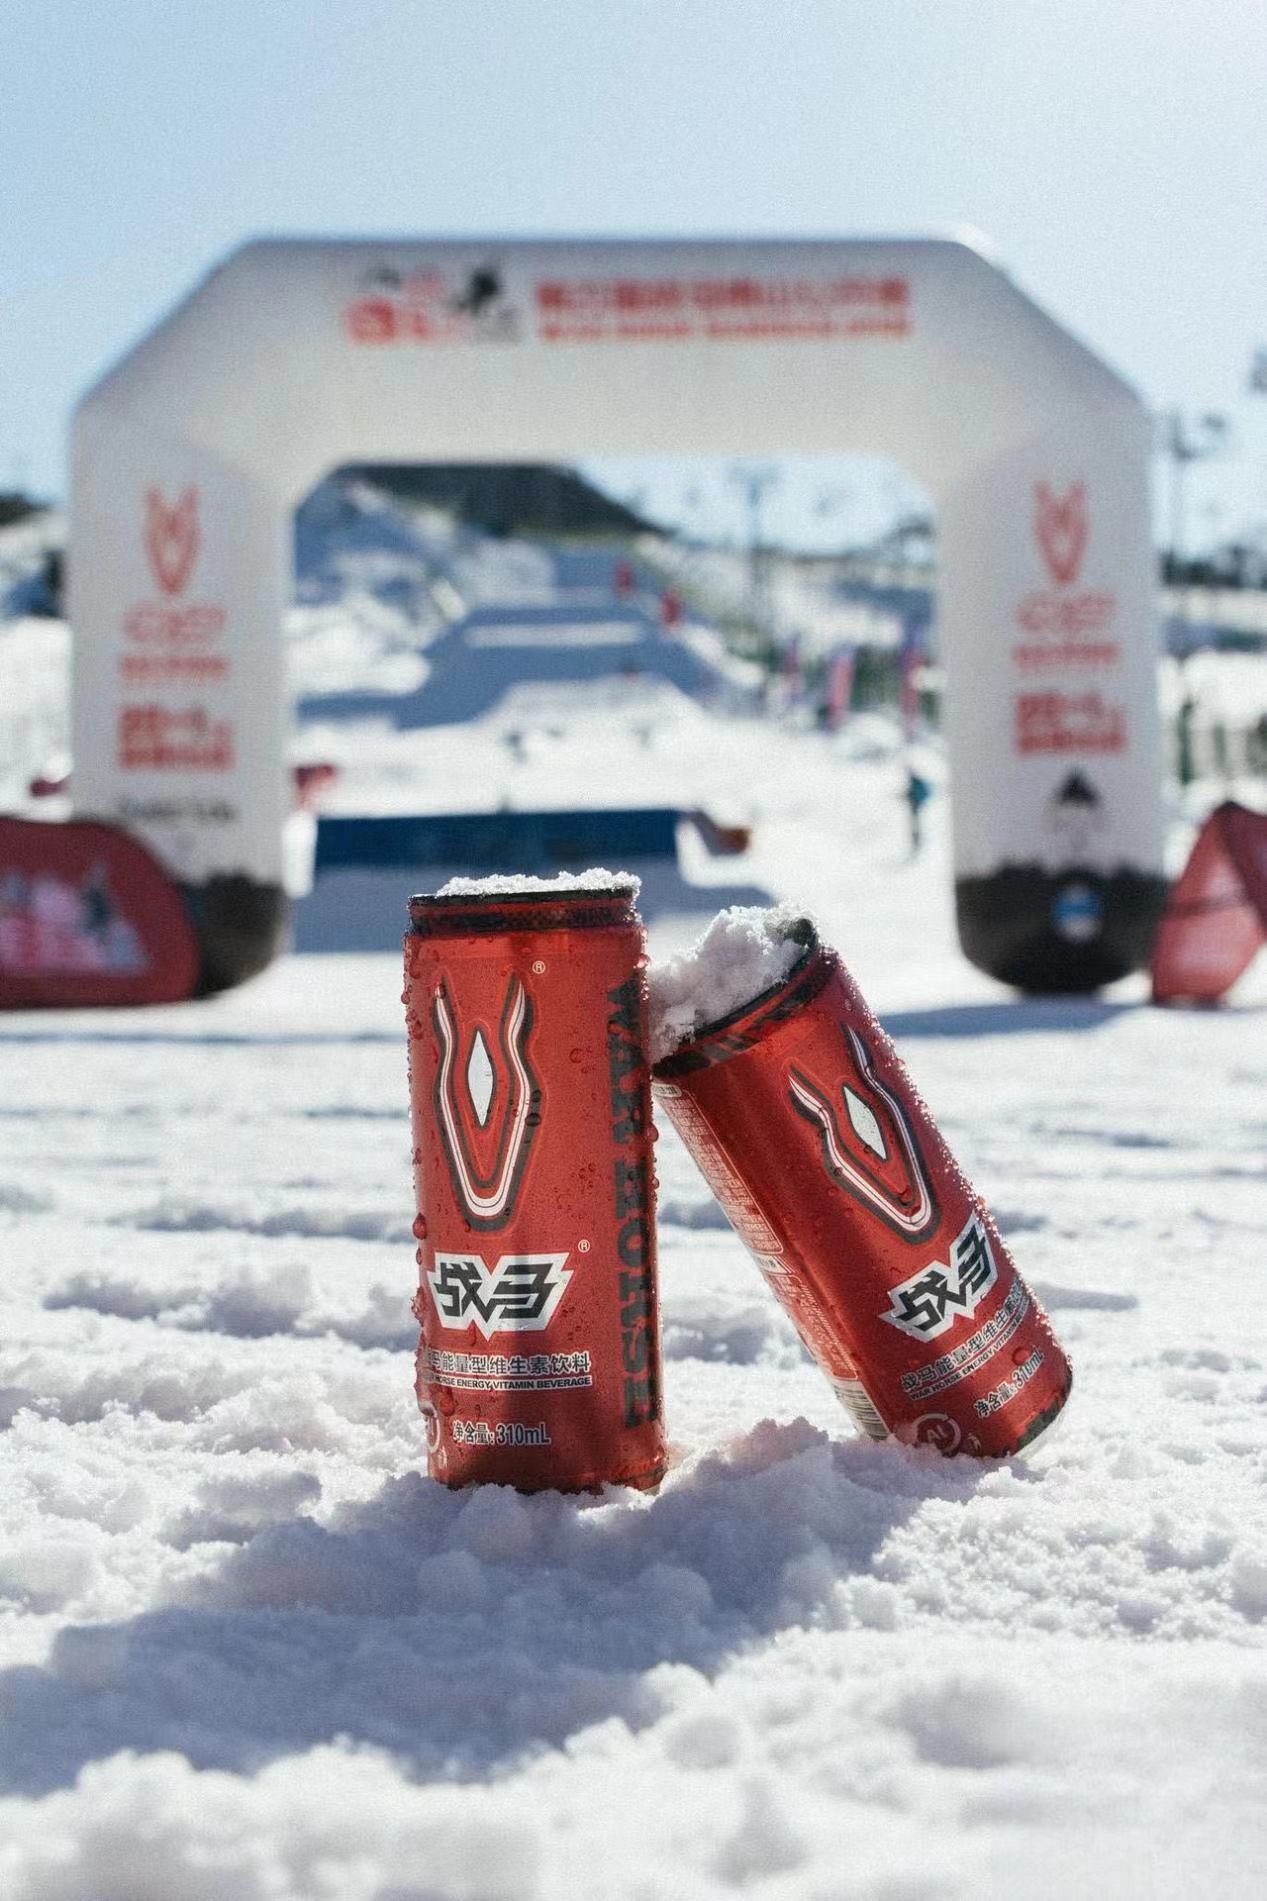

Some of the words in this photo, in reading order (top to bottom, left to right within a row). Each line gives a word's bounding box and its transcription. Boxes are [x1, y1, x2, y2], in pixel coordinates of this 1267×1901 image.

[608, 977, 645, 1145] WAR
[432, 1261, 560, 1324] 战马
[614, 1156, 656, 1430] HORSE
[895, 1222, 993, 1333] 战马
[902, 1275, 1023, 1391] 战马能量型维生素
[428, 1350, 590, 1375] 马能量型维生素饮料
[493, 1380, 534, 1389] VITAMIN
[536, 1376, 591, 1390] BEVERAGE
